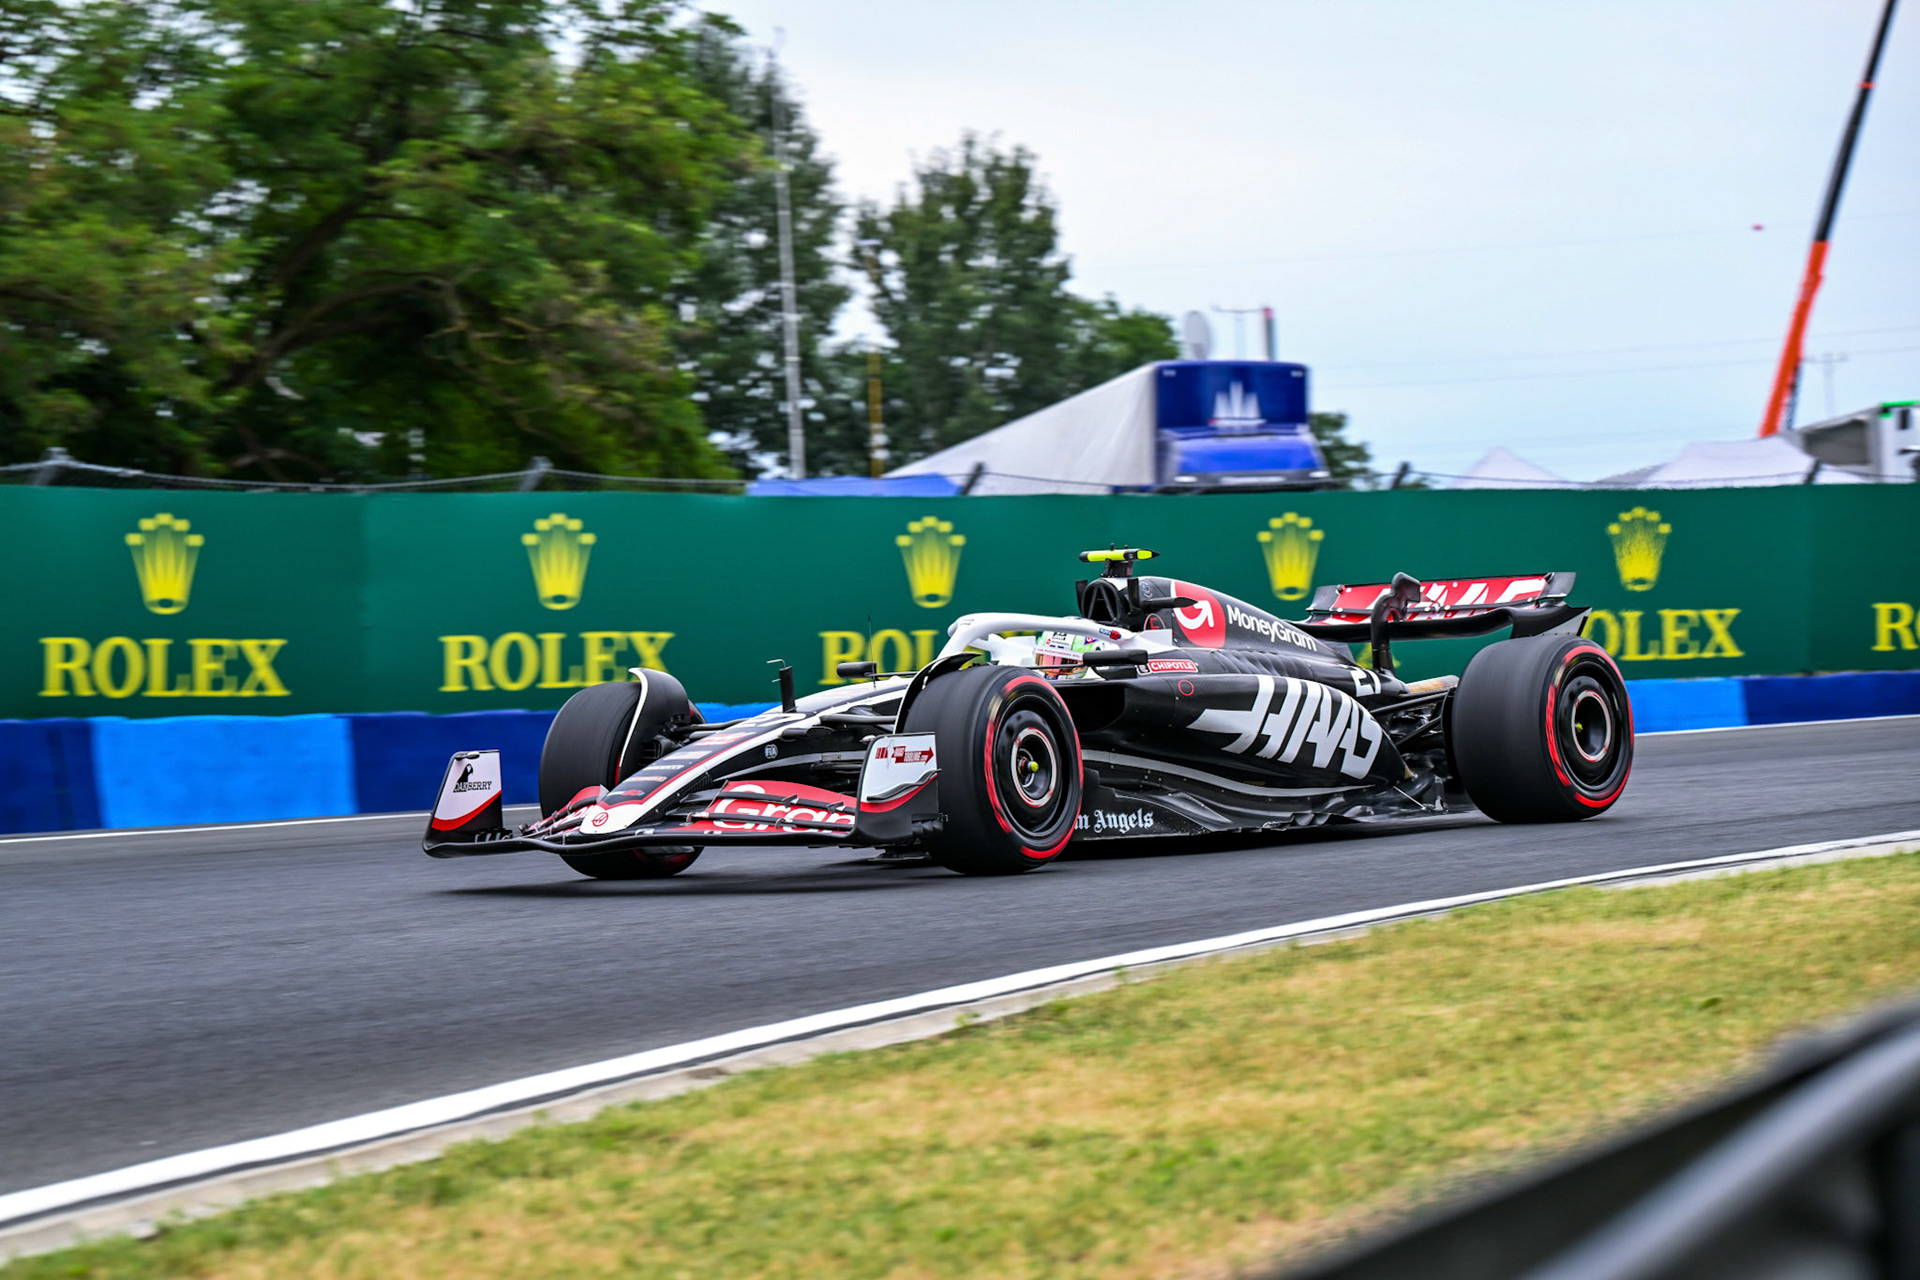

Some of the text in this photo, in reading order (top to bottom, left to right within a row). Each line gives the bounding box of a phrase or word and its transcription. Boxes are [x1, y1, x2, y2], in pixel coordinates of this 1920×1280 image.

[1226, 604, 1317, 651] MoneyGram
[1580, 608, 1745, 661] OLEX
[39, 636, 291, 698] ROLEX
[438, 631, 676, 692] ROLEX
[1150, 661, 1195, 670] CHIPOTLE
[1186, 674, 1383, 780] HAAS
[1093, 807, 1155, 834] Angels
